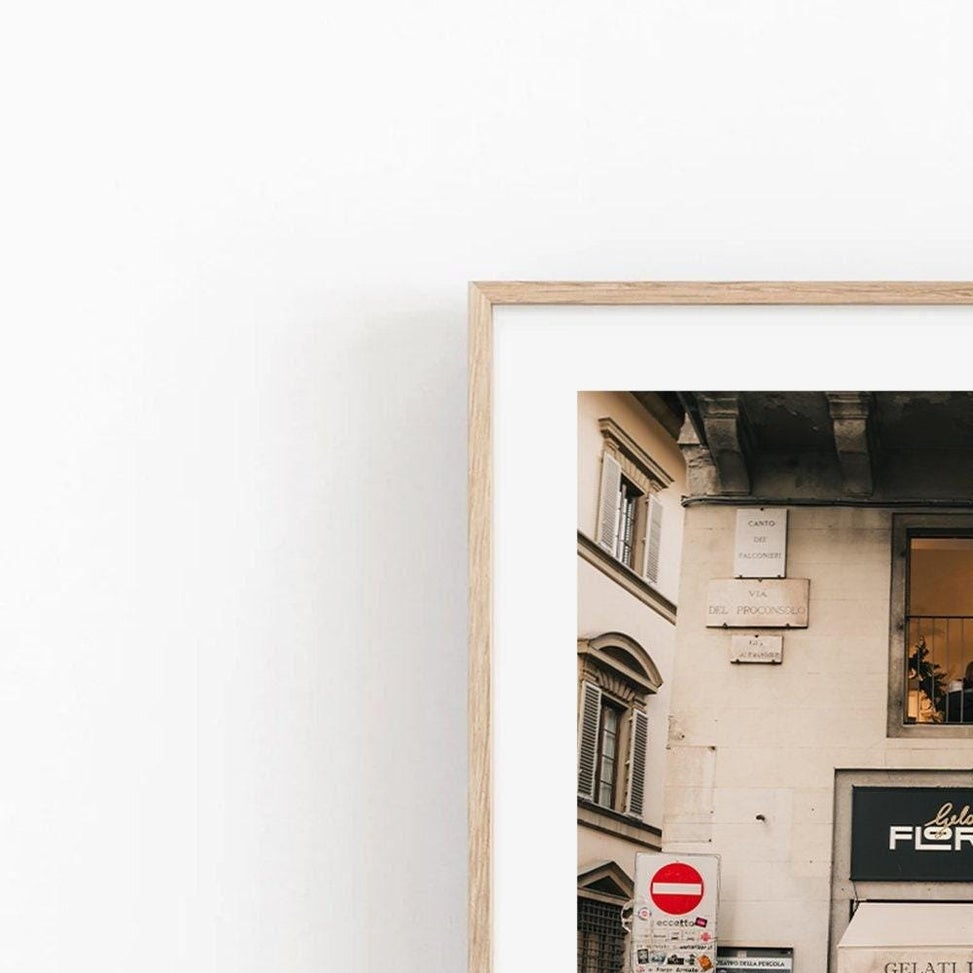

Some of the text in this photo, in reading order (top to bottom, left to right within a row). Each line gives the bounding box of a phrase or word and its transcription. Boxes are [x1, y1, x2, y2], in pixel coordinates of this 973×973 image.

[748, 590, 768, 598] VIA
[708, 606, 806, 615] DEL PROCONSOLO
[656, 919, 695, 928] eccetto
